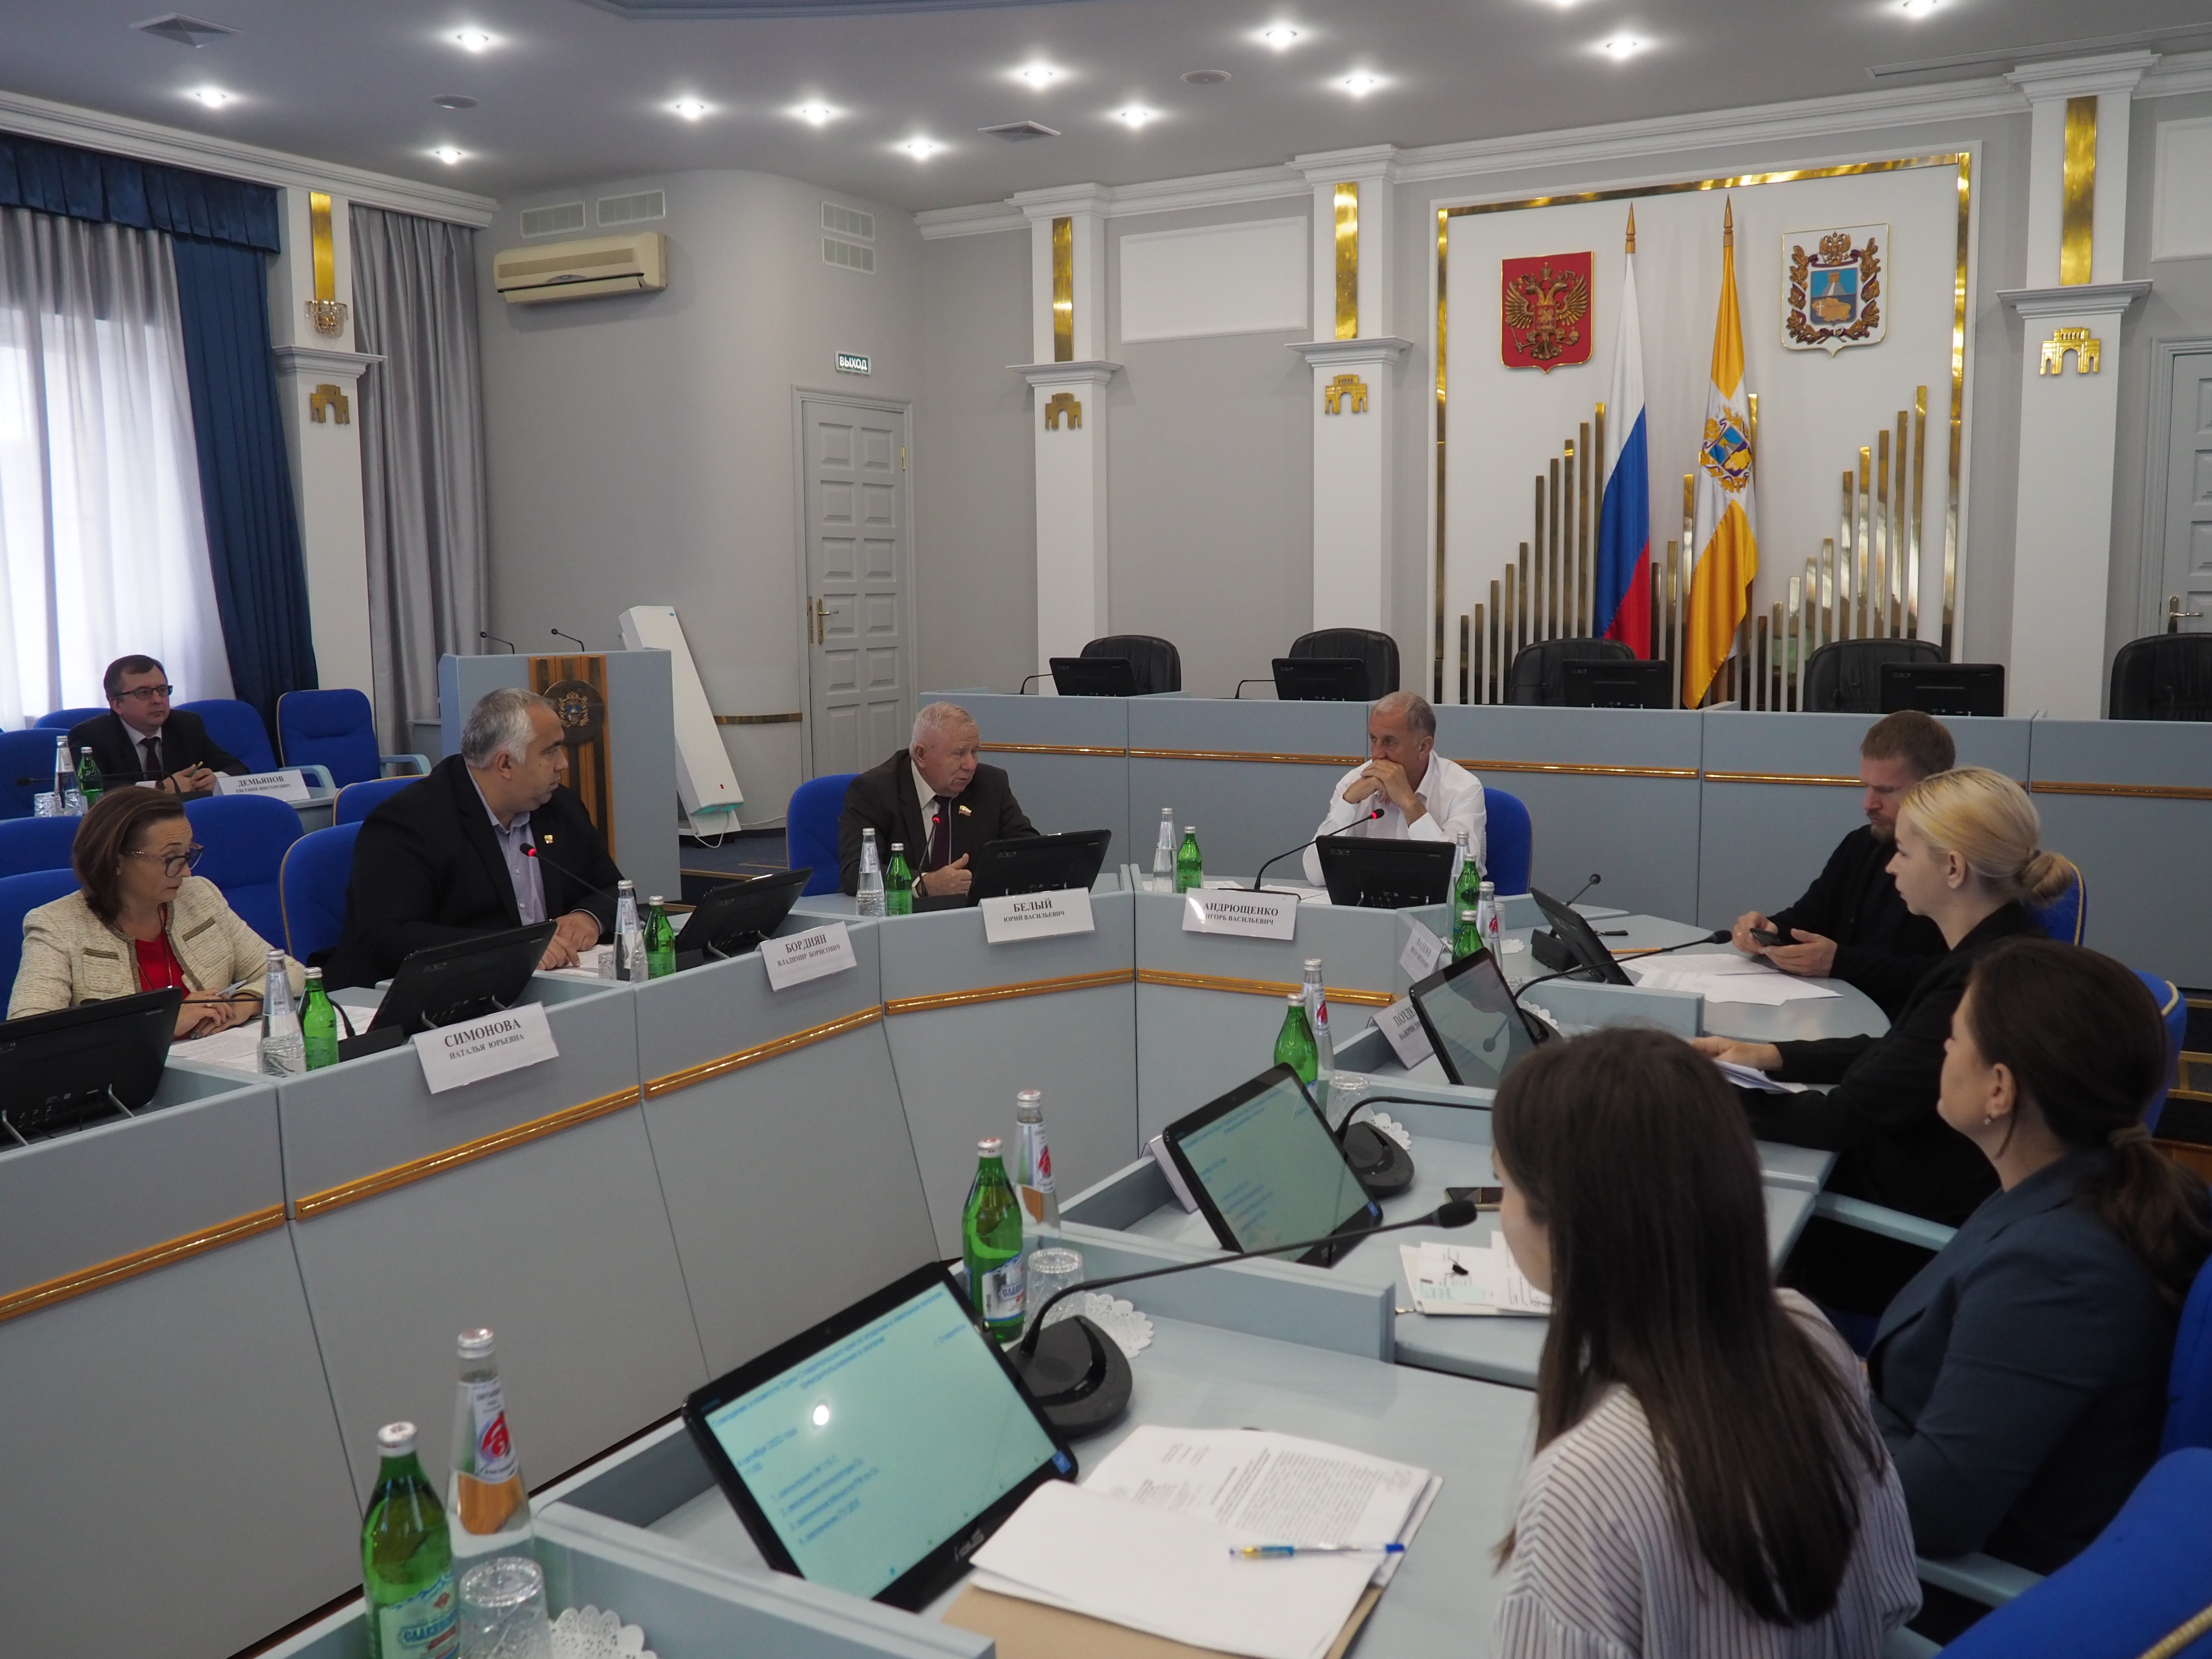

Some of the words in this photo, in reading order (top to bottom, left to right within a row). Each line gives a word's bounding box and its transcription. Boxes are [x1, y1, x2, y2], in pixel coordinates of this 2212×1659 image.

[840, 356, 867, 371] ВЫХОД
[238, 776, 284, 787] ДЕМЬЯНОВ
[1013, 898, 1052, 912] БЕЛЫЙ
[1203, 902, 1279, 916] АНДРЮЩЕНКО
[1004, 914, 1023, 922] ЮРИЙ
[1024, 911, 1065, 920] ВАСИЛЬЕВИЧ
[1228, 915, 1274, 925] ВАСИЛЬЕВИЧ
[785, 934, 827, 953] БОРДИЯН
[777, 953, 807, 966] ВЛАДИМИР
[809, 944, 841, 958] БОРИСОВИЧ
[1393, 1005, 1416, 1026] ПОЗДЕ
[445, 1019, 521, 1047] СИМОНОВА
[449, 1044, 485, 1059] НАТАЛЬЯ
[488, 1034, 524, 1049] ЮРЬЕВНА
